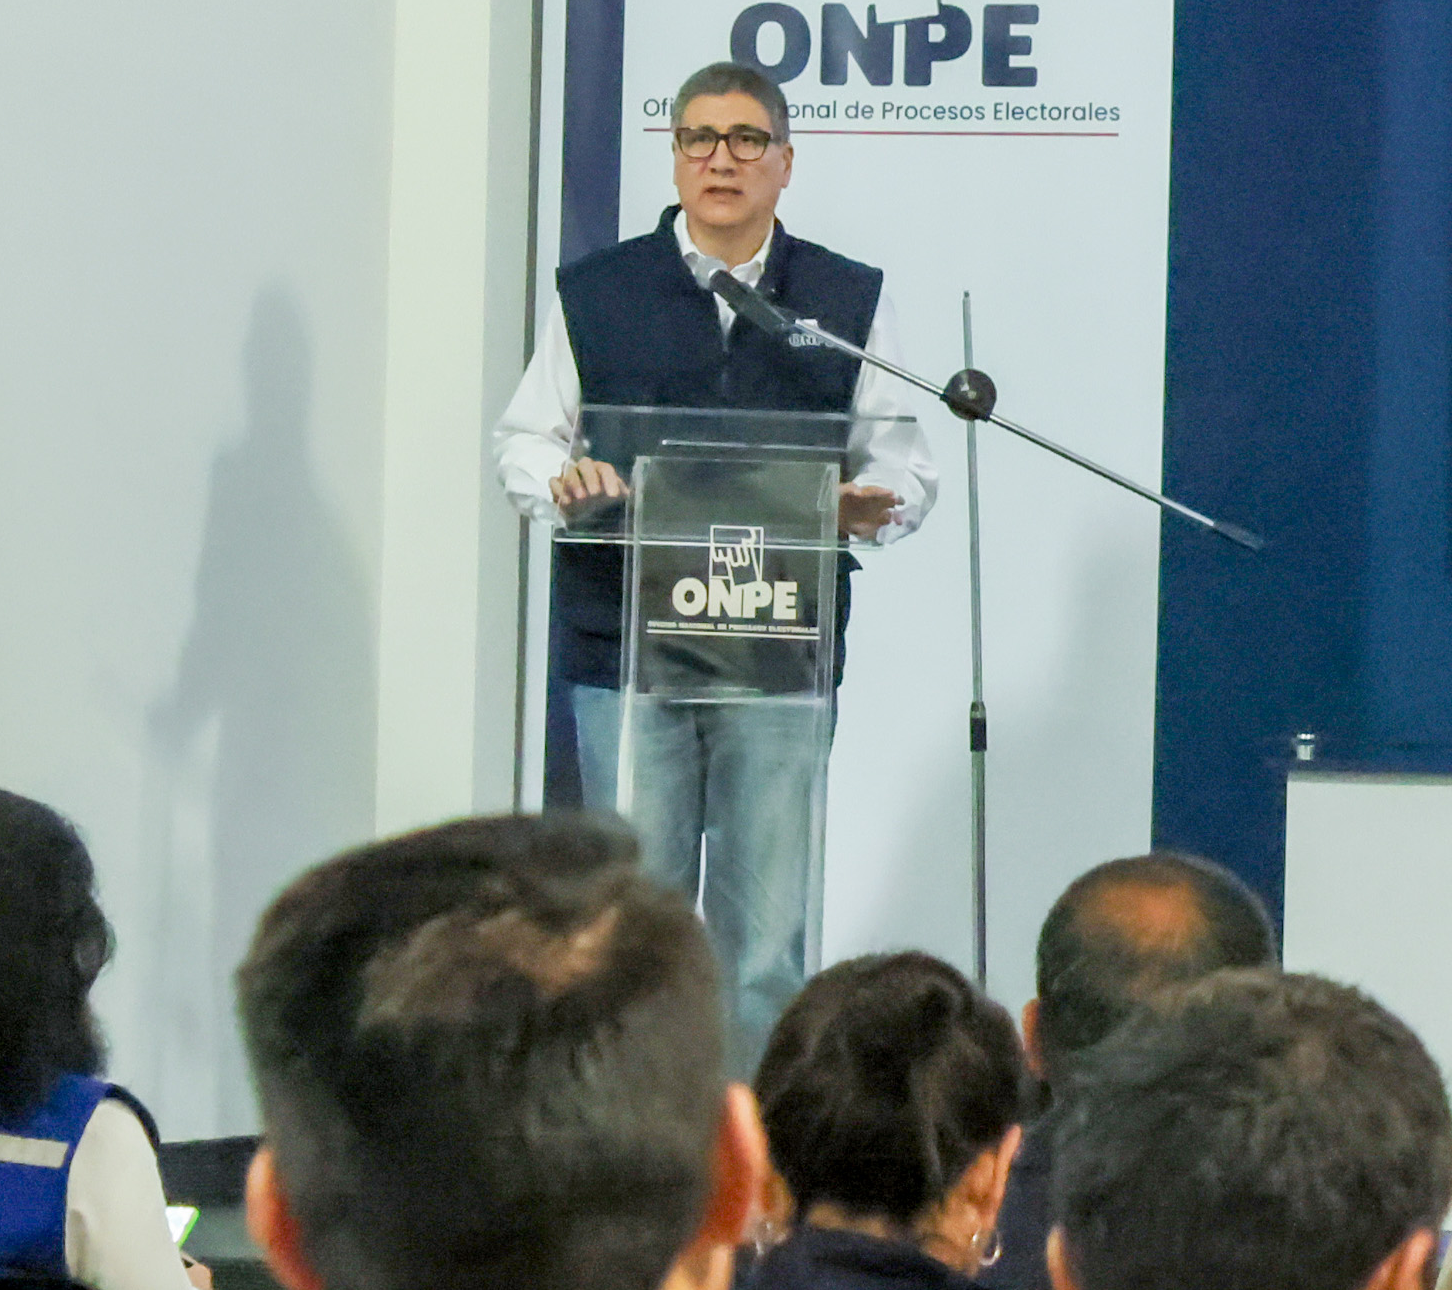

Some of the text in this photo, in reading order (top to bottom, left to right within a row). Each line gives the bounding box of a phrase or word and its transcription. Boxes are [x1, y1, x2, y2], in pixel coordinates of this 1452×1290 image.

[730, 2, 1040, 87] ONPE
[844, 100, 874, 120] de
[881, 101, 986, 121] Procesos
[994, 102, 1121, 122] Electorales
[671, 576, 798, 620] ONPE
